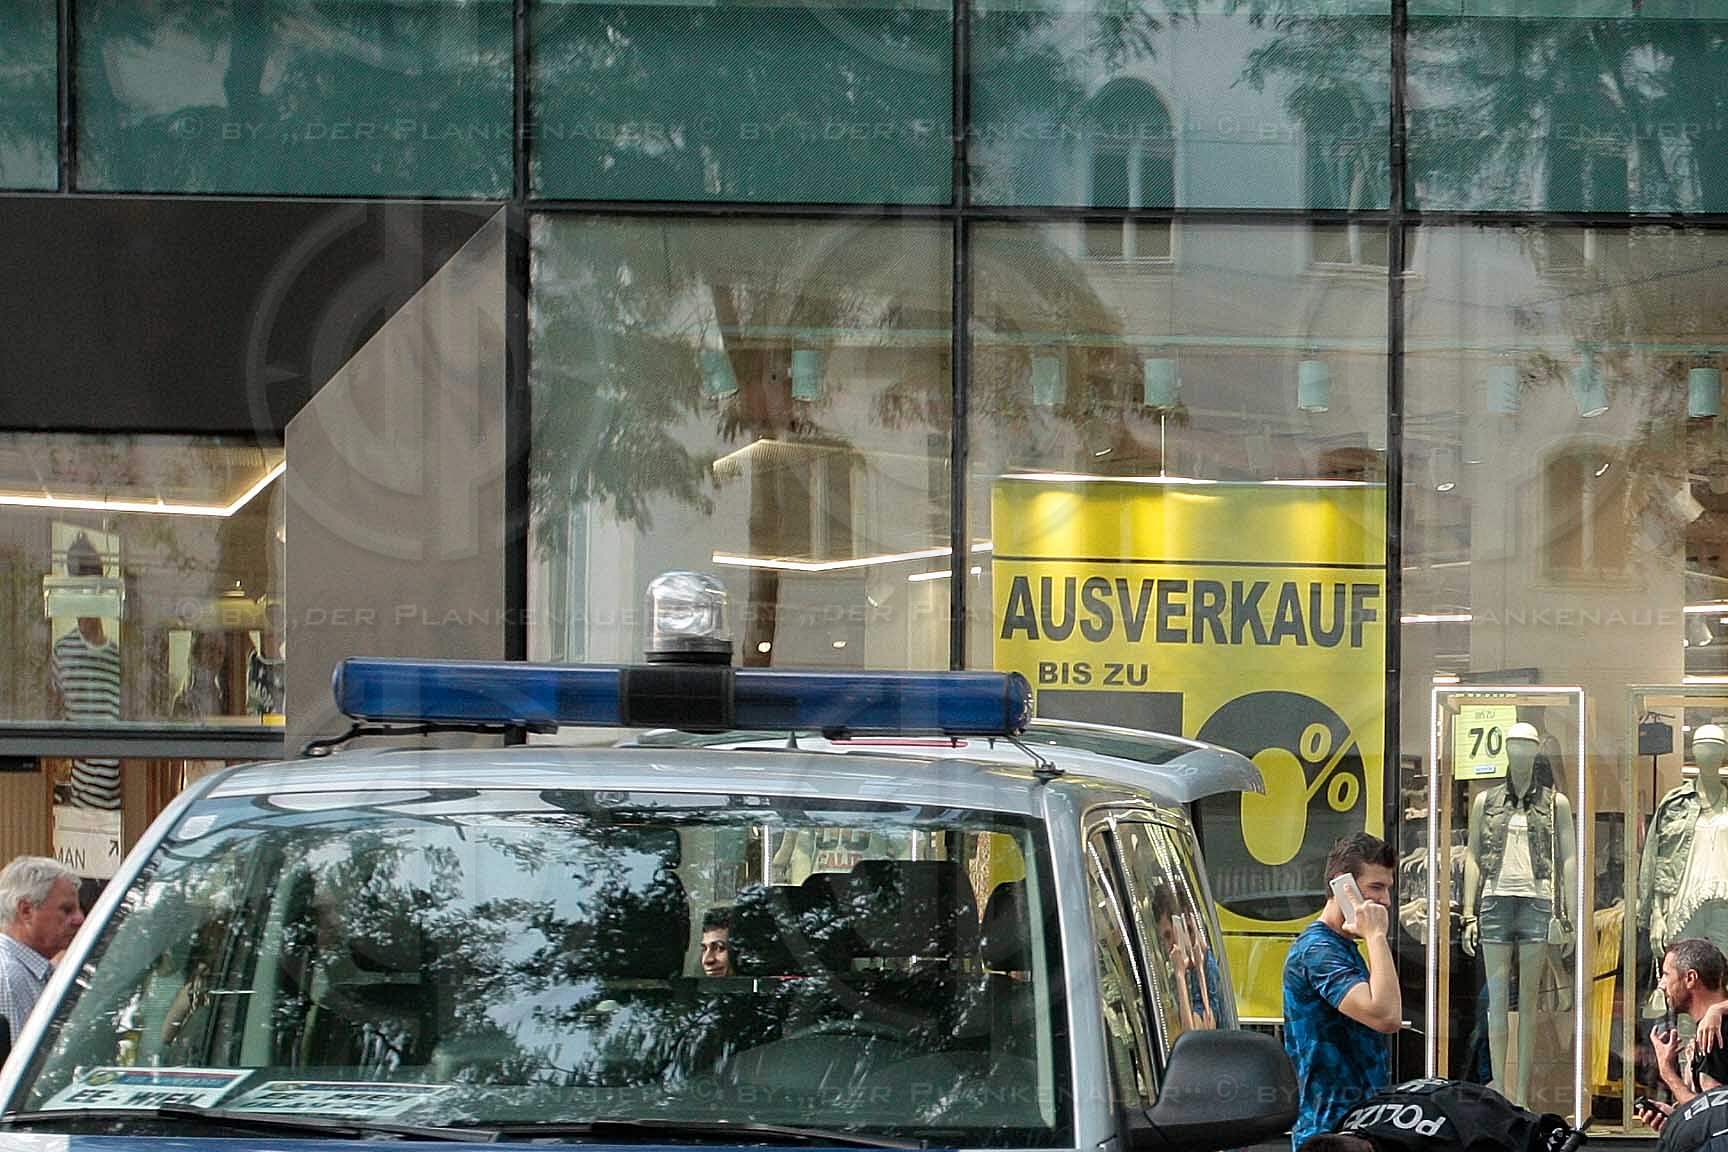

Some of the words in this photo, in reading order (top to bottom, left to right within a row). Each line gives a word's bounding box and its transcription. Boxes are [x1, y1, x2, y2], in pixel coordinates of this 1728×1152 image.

[1000, 576, 1381, 649] AUSVERKAUF
[1038, 662, 1093, 686] BIS
[1103, 663, 1149, 687] ZU
[1469, 726, 1503, 758] 70
